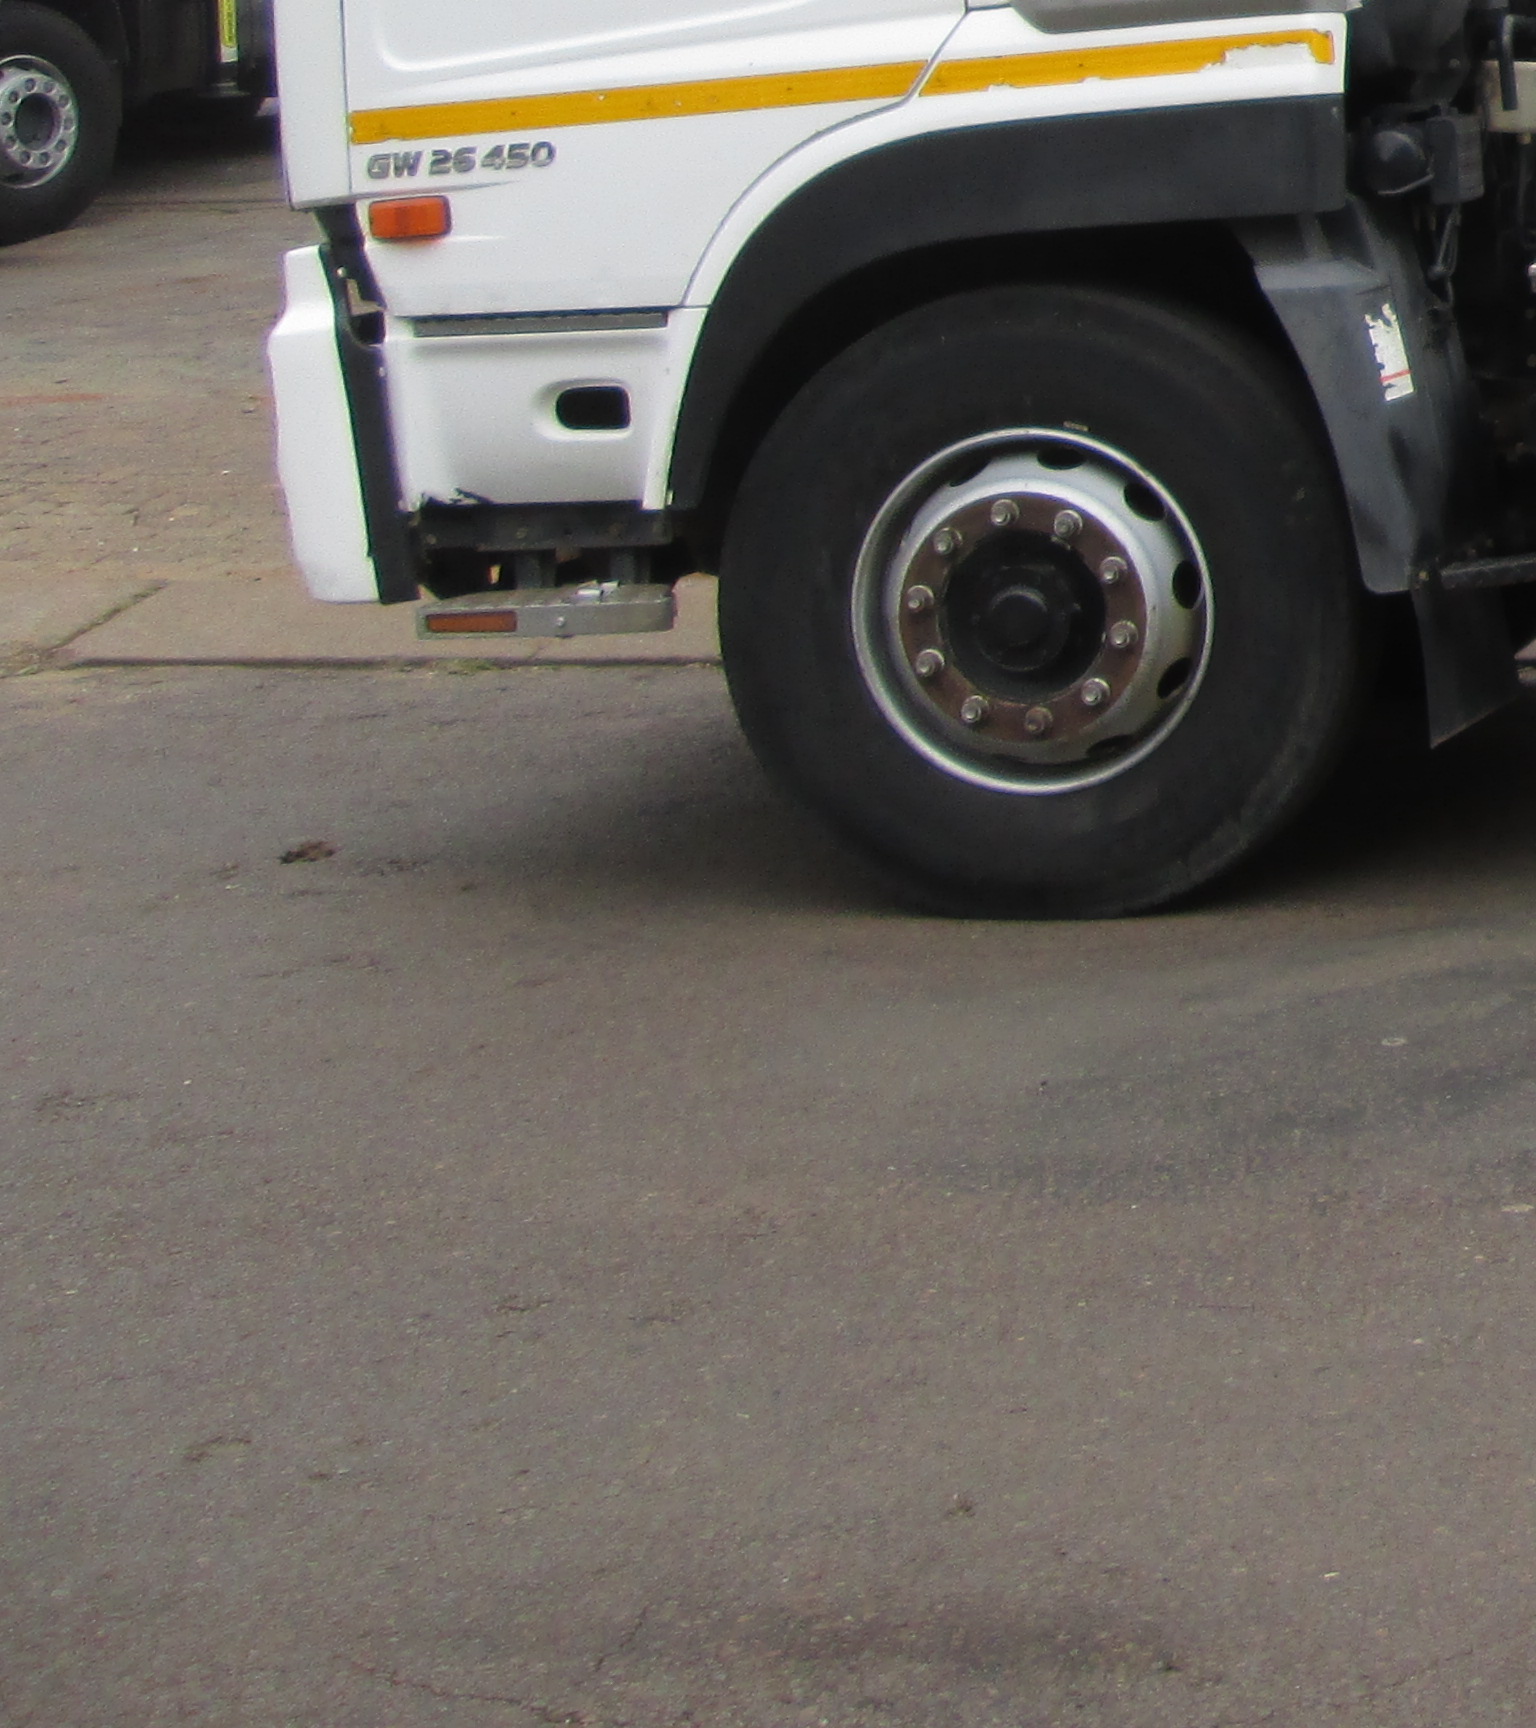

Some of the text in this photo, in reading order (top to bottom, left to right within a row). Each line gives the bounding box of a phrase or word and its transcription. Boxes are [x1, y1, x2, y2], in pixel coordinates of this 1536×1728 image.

[367, 140, 557, 179] GW 26 450
